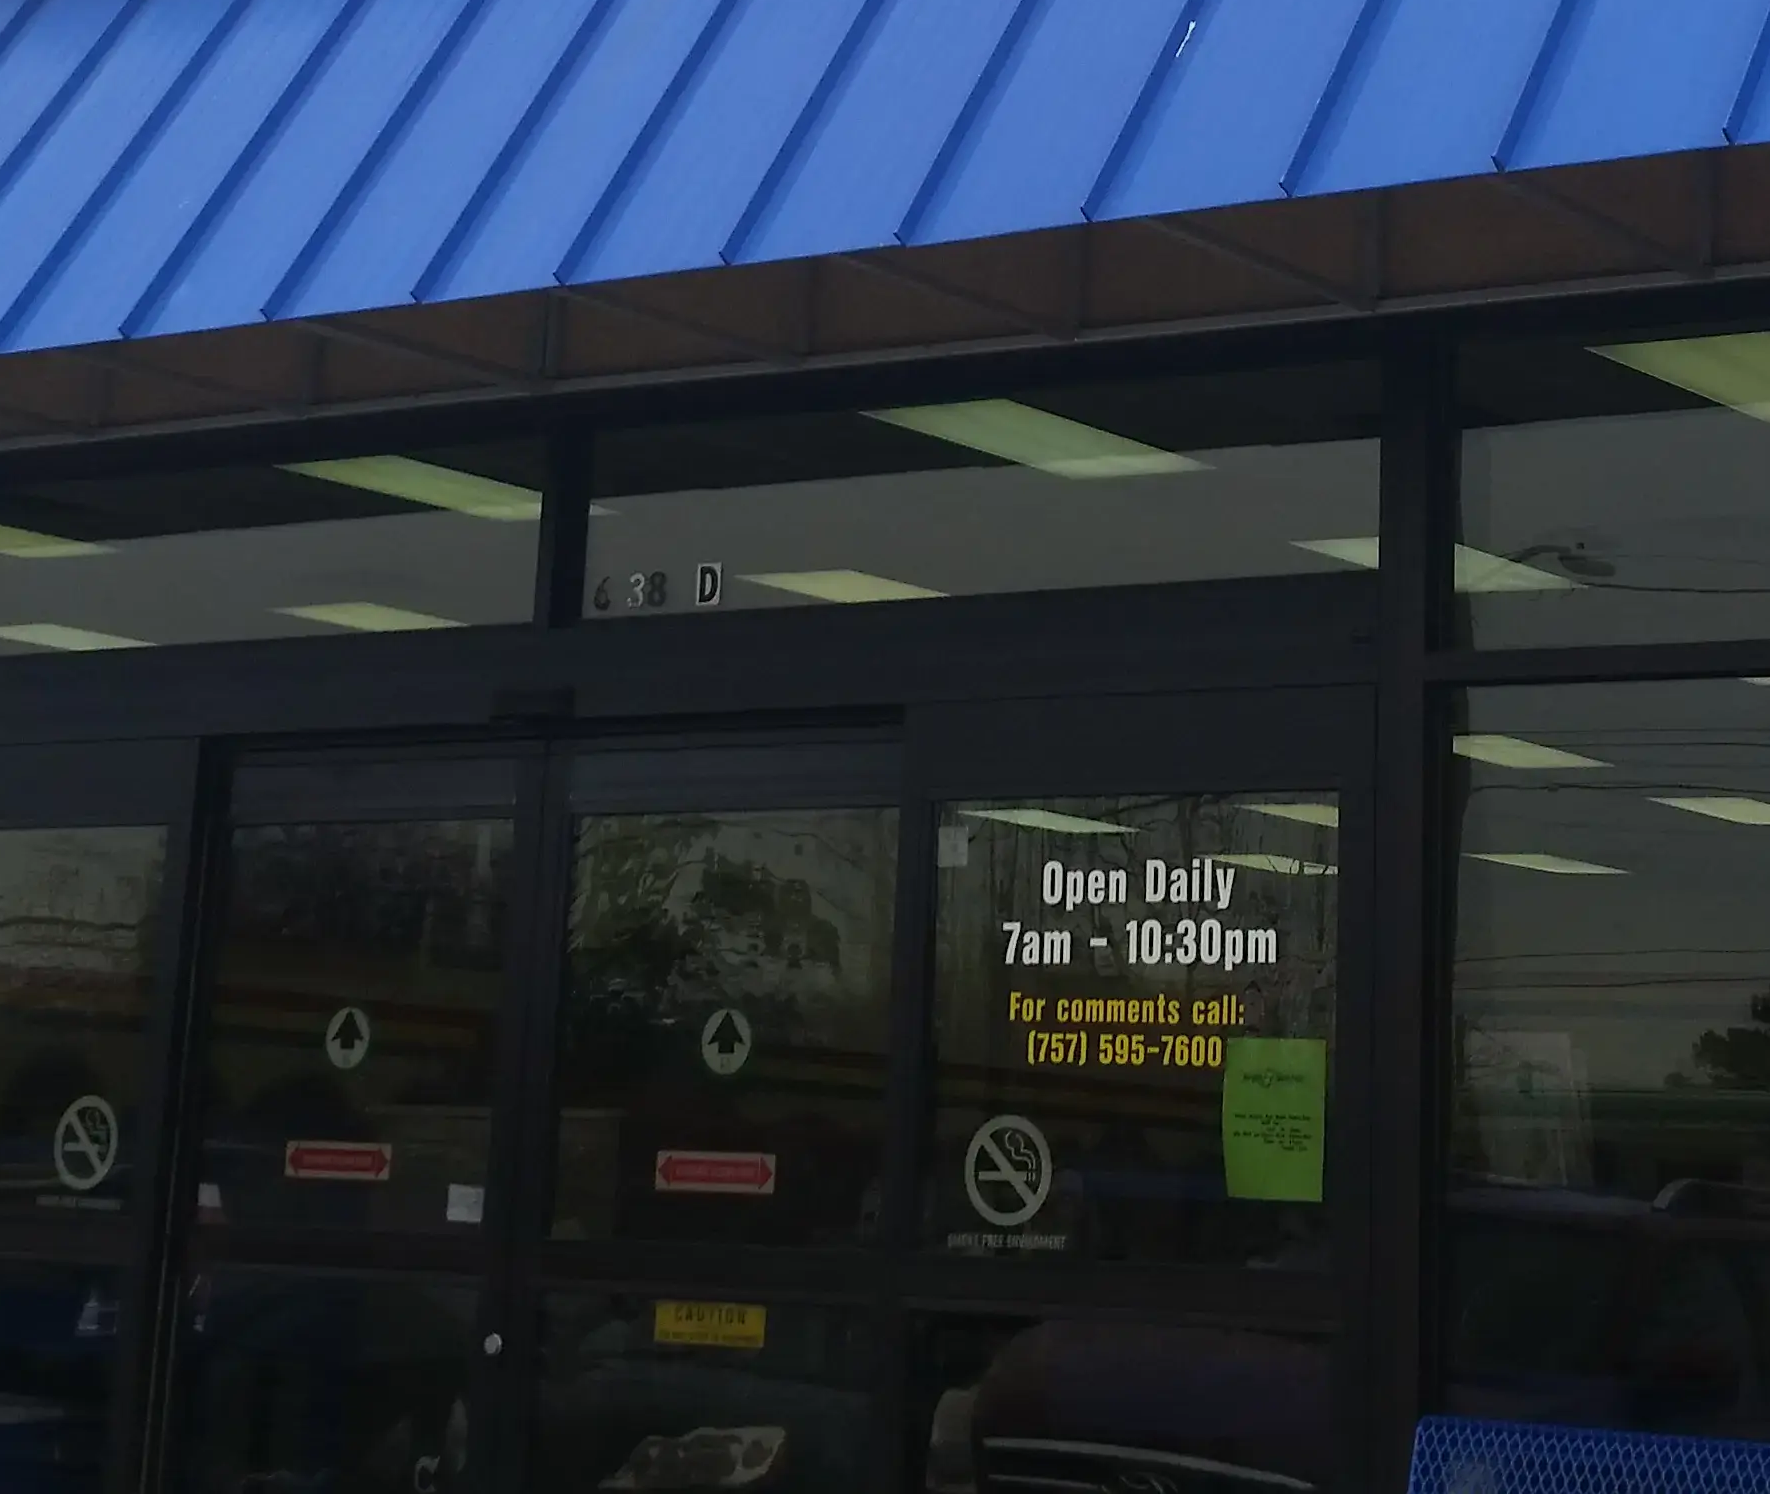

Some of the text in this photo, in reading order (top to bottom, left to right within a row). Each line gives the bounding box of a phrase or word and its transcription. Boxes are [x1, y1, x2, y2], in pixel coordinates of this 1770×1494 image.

[698, 565, 720, 604] D
[1041, 857, 1235, 911] Open Daily
[1002, 921, 1072, 965] 7am
[1125, 918, 1278, 971] 10:30pm
[1009, 991, 1245, 1026] For comments call:
[1027, 1030, 1223, 1067] (757) 595-7600
[674, 1304, 748, 1326] CAUTION
